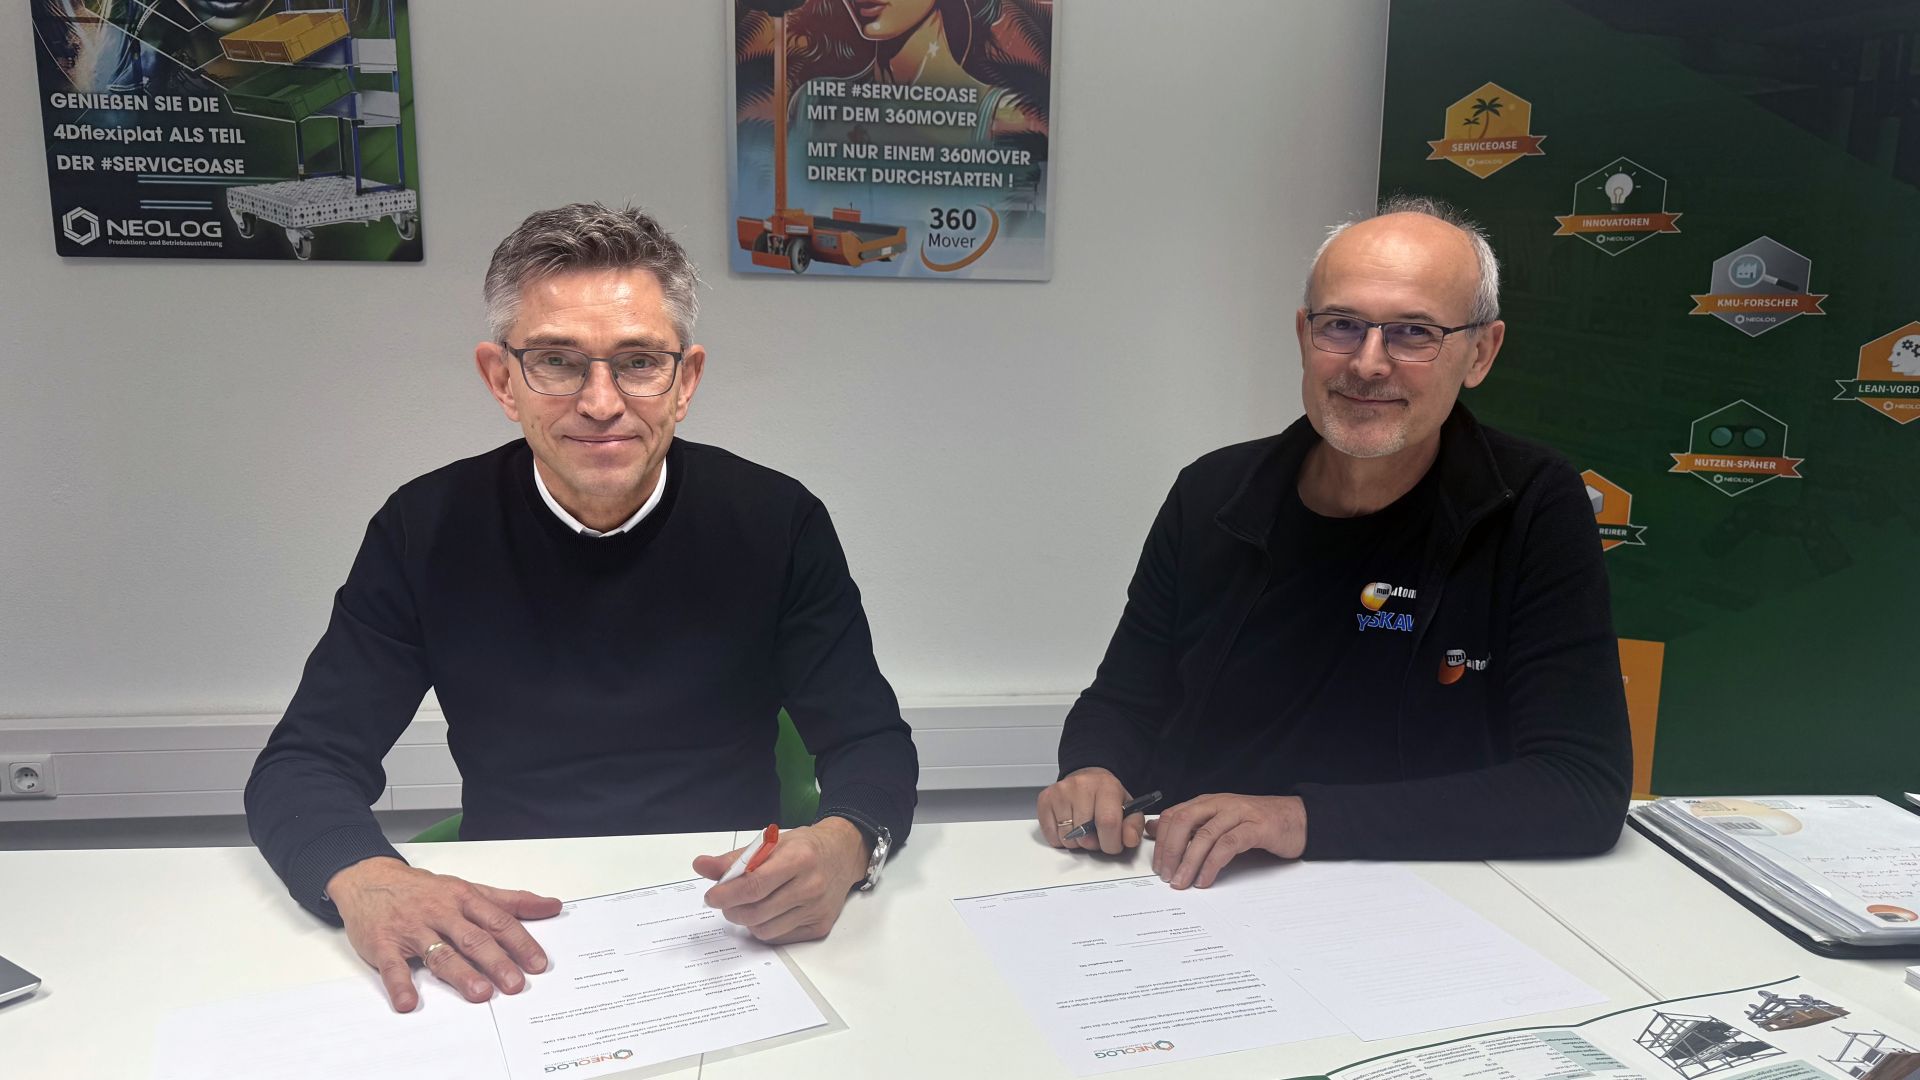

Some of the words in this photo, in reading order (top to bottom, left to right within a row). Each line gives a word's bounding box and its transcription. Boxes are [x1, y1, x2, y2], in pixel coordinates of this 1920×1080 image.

[807, 81, 846, 97] IHRE
[851, 82, 977, 103] #SERVICEOASE
[50, 92, 149, 111] GENIEßEN
[154, 95, 183, 112] SIE
[188, 96, 220, 113] DIE
[807, 105, 838, 121] MIT
[842, 106, 880, 123] DEM
[885, 108, 977, 127] 360MOVER
[53, 124, 163, 144] 4Dflexiplat
[169, 127, 204, 143] ALS
[208, 128, 246, 144] TEIL
[807, 142, 838, 158] MIT
[842, 143, 879, 160] NUR
[883, 144, 935, 162] EINEM
[940, 147, 1031, 166] 360MOVER
[1451, 140, 1518, 152] SERVICEOASE
[56, 155, 95, 171] DER
[101, 156, 245, 175] #SERVICEOASE
[807, 165, 867, 183] DIREKT
[871, 168, 1003, 188] DURCHSTARTEN
[1008, 173, 1014, 188] !
[106, 219, 222, 238] NEOLOG
[929, 207, 977, 231] 360
[1582, 217, 1650, 227] INNOVATOREN
[161, 240, 223, 248] Betriebsausstattung
[928, 232, 976, 249] Mover
[1717, 298, 1799, 308] KMU-FORSCHER
[1858, 384, 1920, 394] LEAN-VORD
[1694, 457, 1777, 470] NUTZEN-SPÄHER
[1095, 1043, 1157, 1059] NEOLOG
[544, 1053, 613, 1073] NEOLOG
